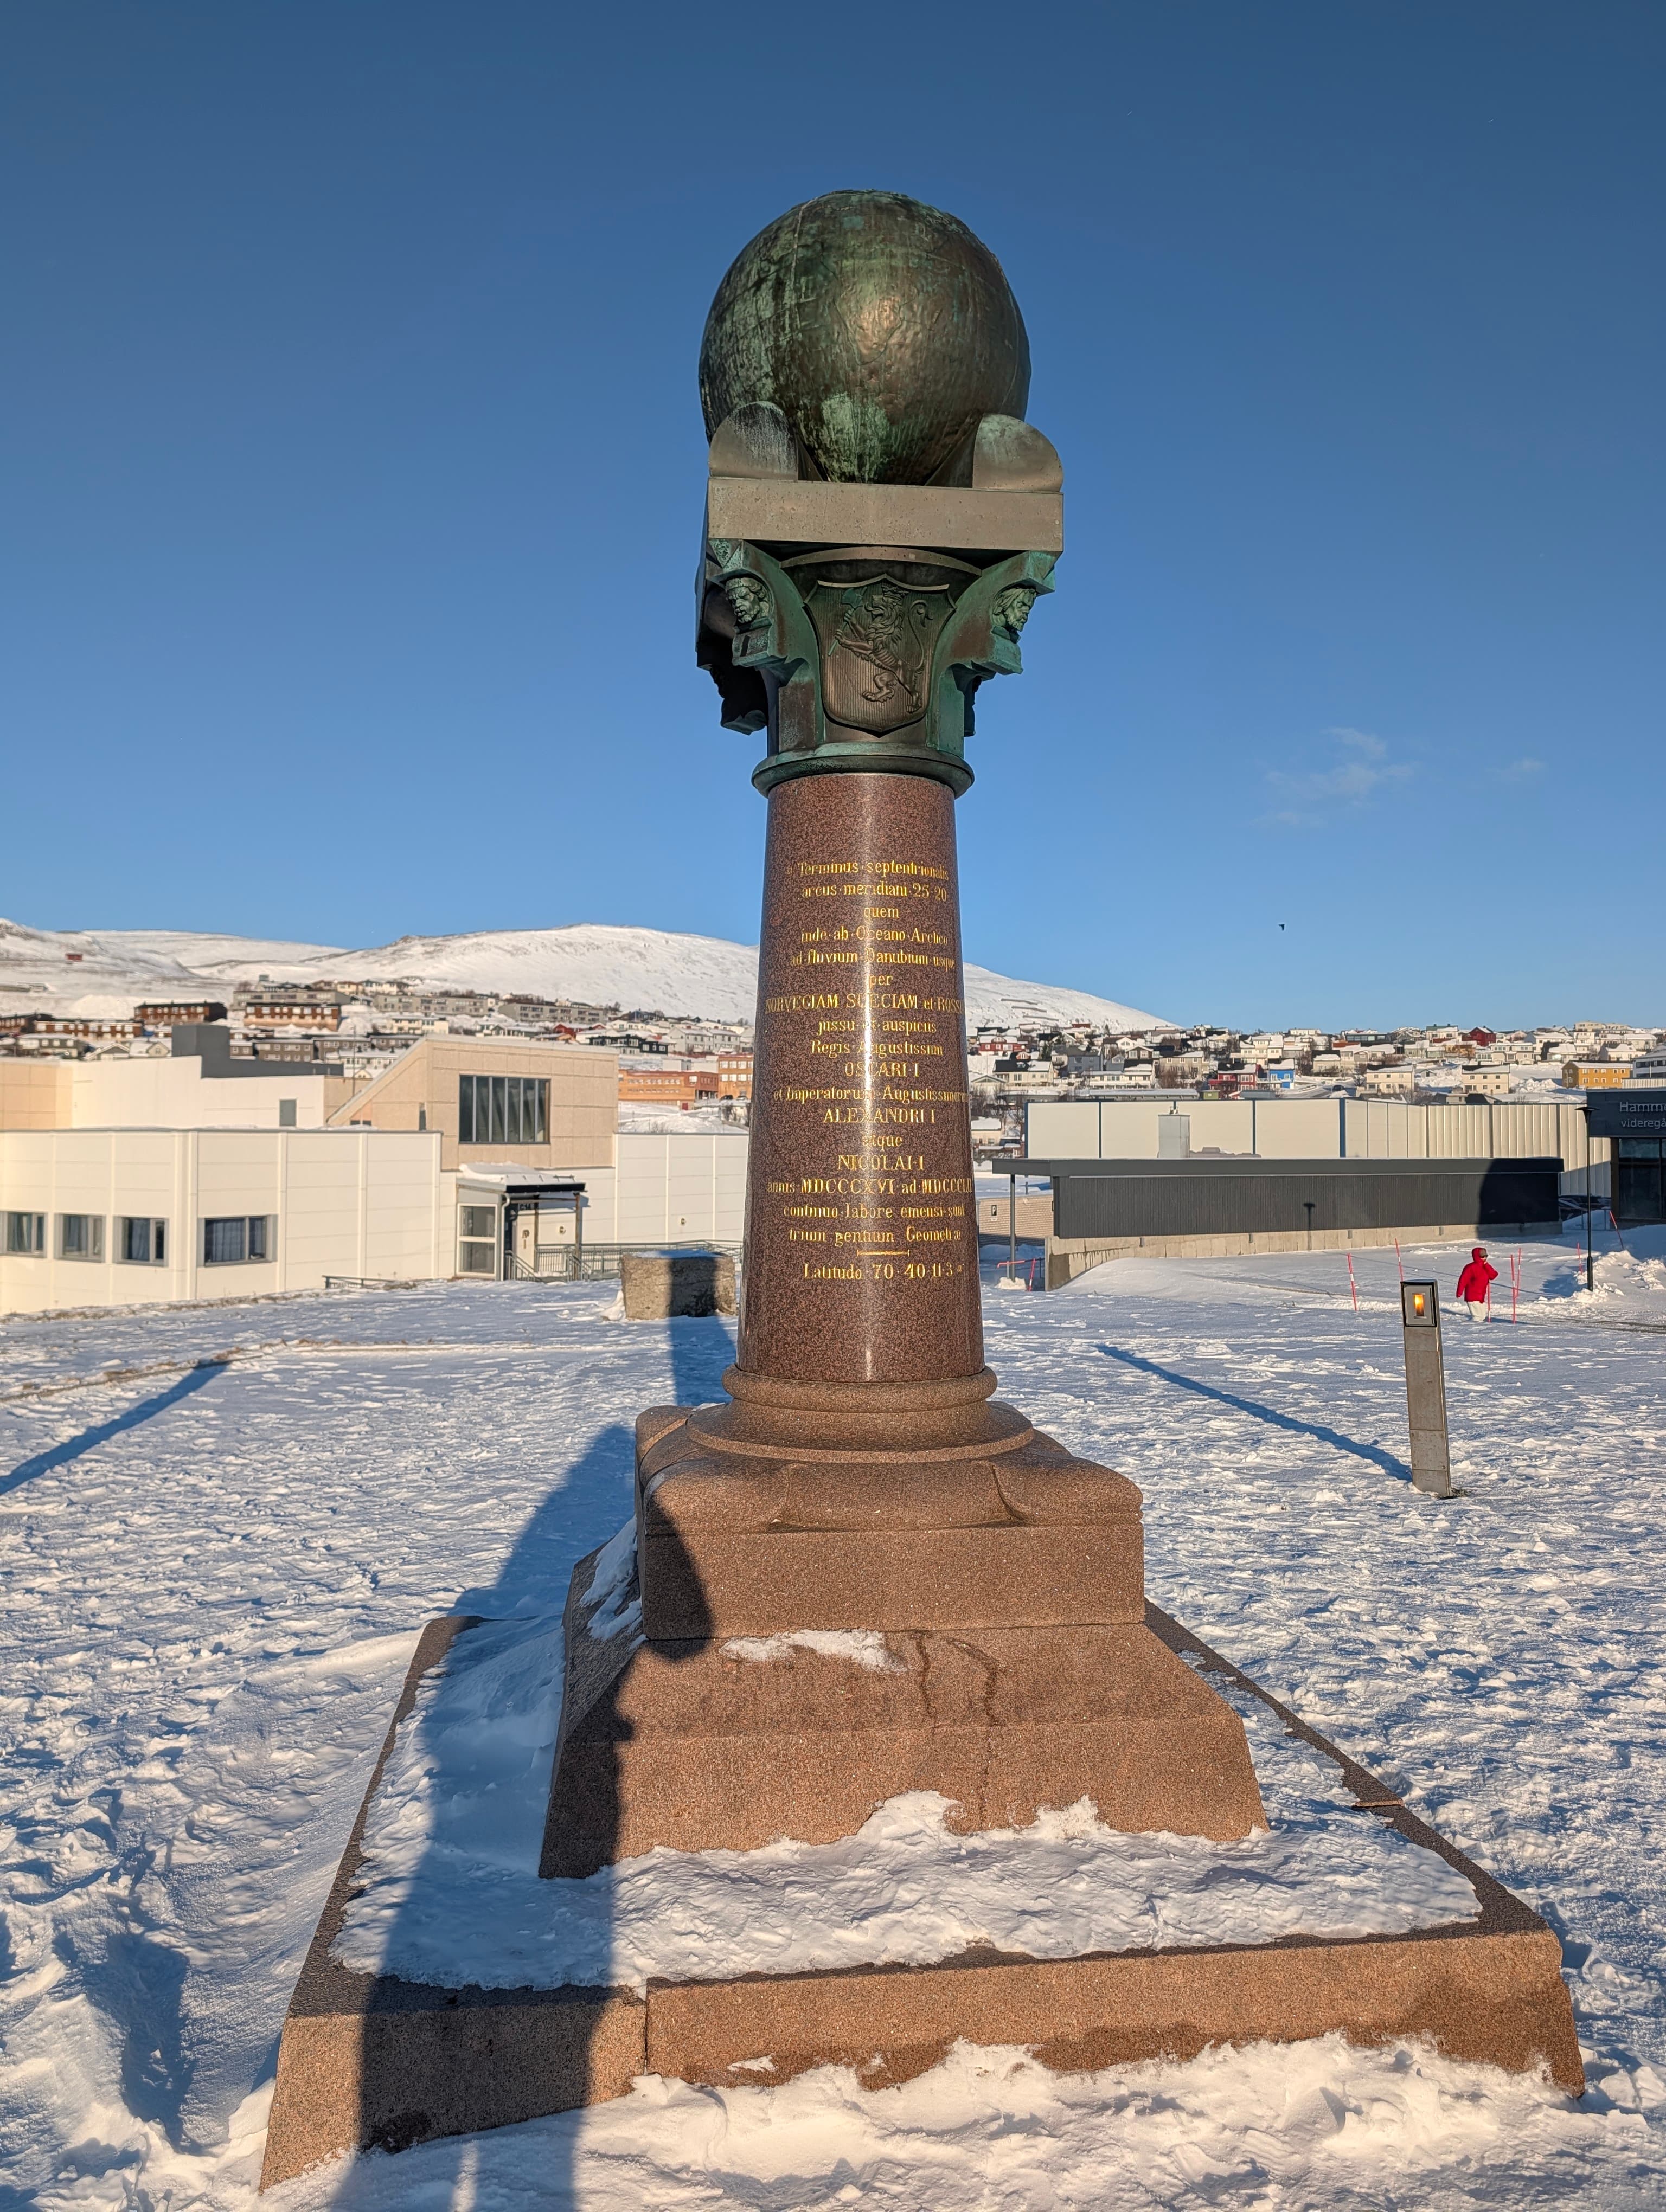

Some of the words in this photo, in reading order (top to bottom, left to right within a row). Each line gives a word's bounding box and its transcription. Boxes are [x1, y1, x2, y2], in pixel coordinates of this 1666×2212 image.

[798, 860, 858, 877] Terminus
[867, 860, 949, 881] septentrionalis
[802, 885, 837, 898] arcus
[844, 880, 907, 897] meridiani
[864, 907, 900, 921] quem
[802, 927, 826, 942] inde
[834, 926, 849, 941] ab
[856, 925, 905, 941] Oceano
[910, 928, 948, 946] Arctico
[790, 951, 803, 966] ad
[808, 949, 858, 964] fluvium
[865, 948, 928, 966] Danubium
[869, 975, 893, 989] per
[846, 993, 918, 1009] SUECIAM
[924, 998, 933, 1010] et
[817, 1017, 855, 1036] jussu
[862, 1018, 877, 1031] et
[811, 1039, 850, 1058] Regis
[845, 1061, 907, 1077] OSCARI
[773, 1088, 782, 1101] et
[786, 1085, 875, 1105] Imperatorum
[822, 1107, 924, 1124] ALEXANDRI
[863, 1135, 902, 1151] atque
[837, 1155, 912, 1171] NICOLAI
[801, 1178, 895, 1194] MDCCCXVI
[901, 1179, 917, 1194] ad
[784, 1203, 838, 1218] continuo
[845, 1203, 893, 1218] labore
[901, 1203, 943, 1218] emensi
[948, 1203, 965, 1218] sunt
[790, 1226, 826, 1242] trium
[835, 1227, 894, 1246] gentium
[803, 1263, 862, 1279] Latitudo
[872, 1263, 894, 1279] 70
